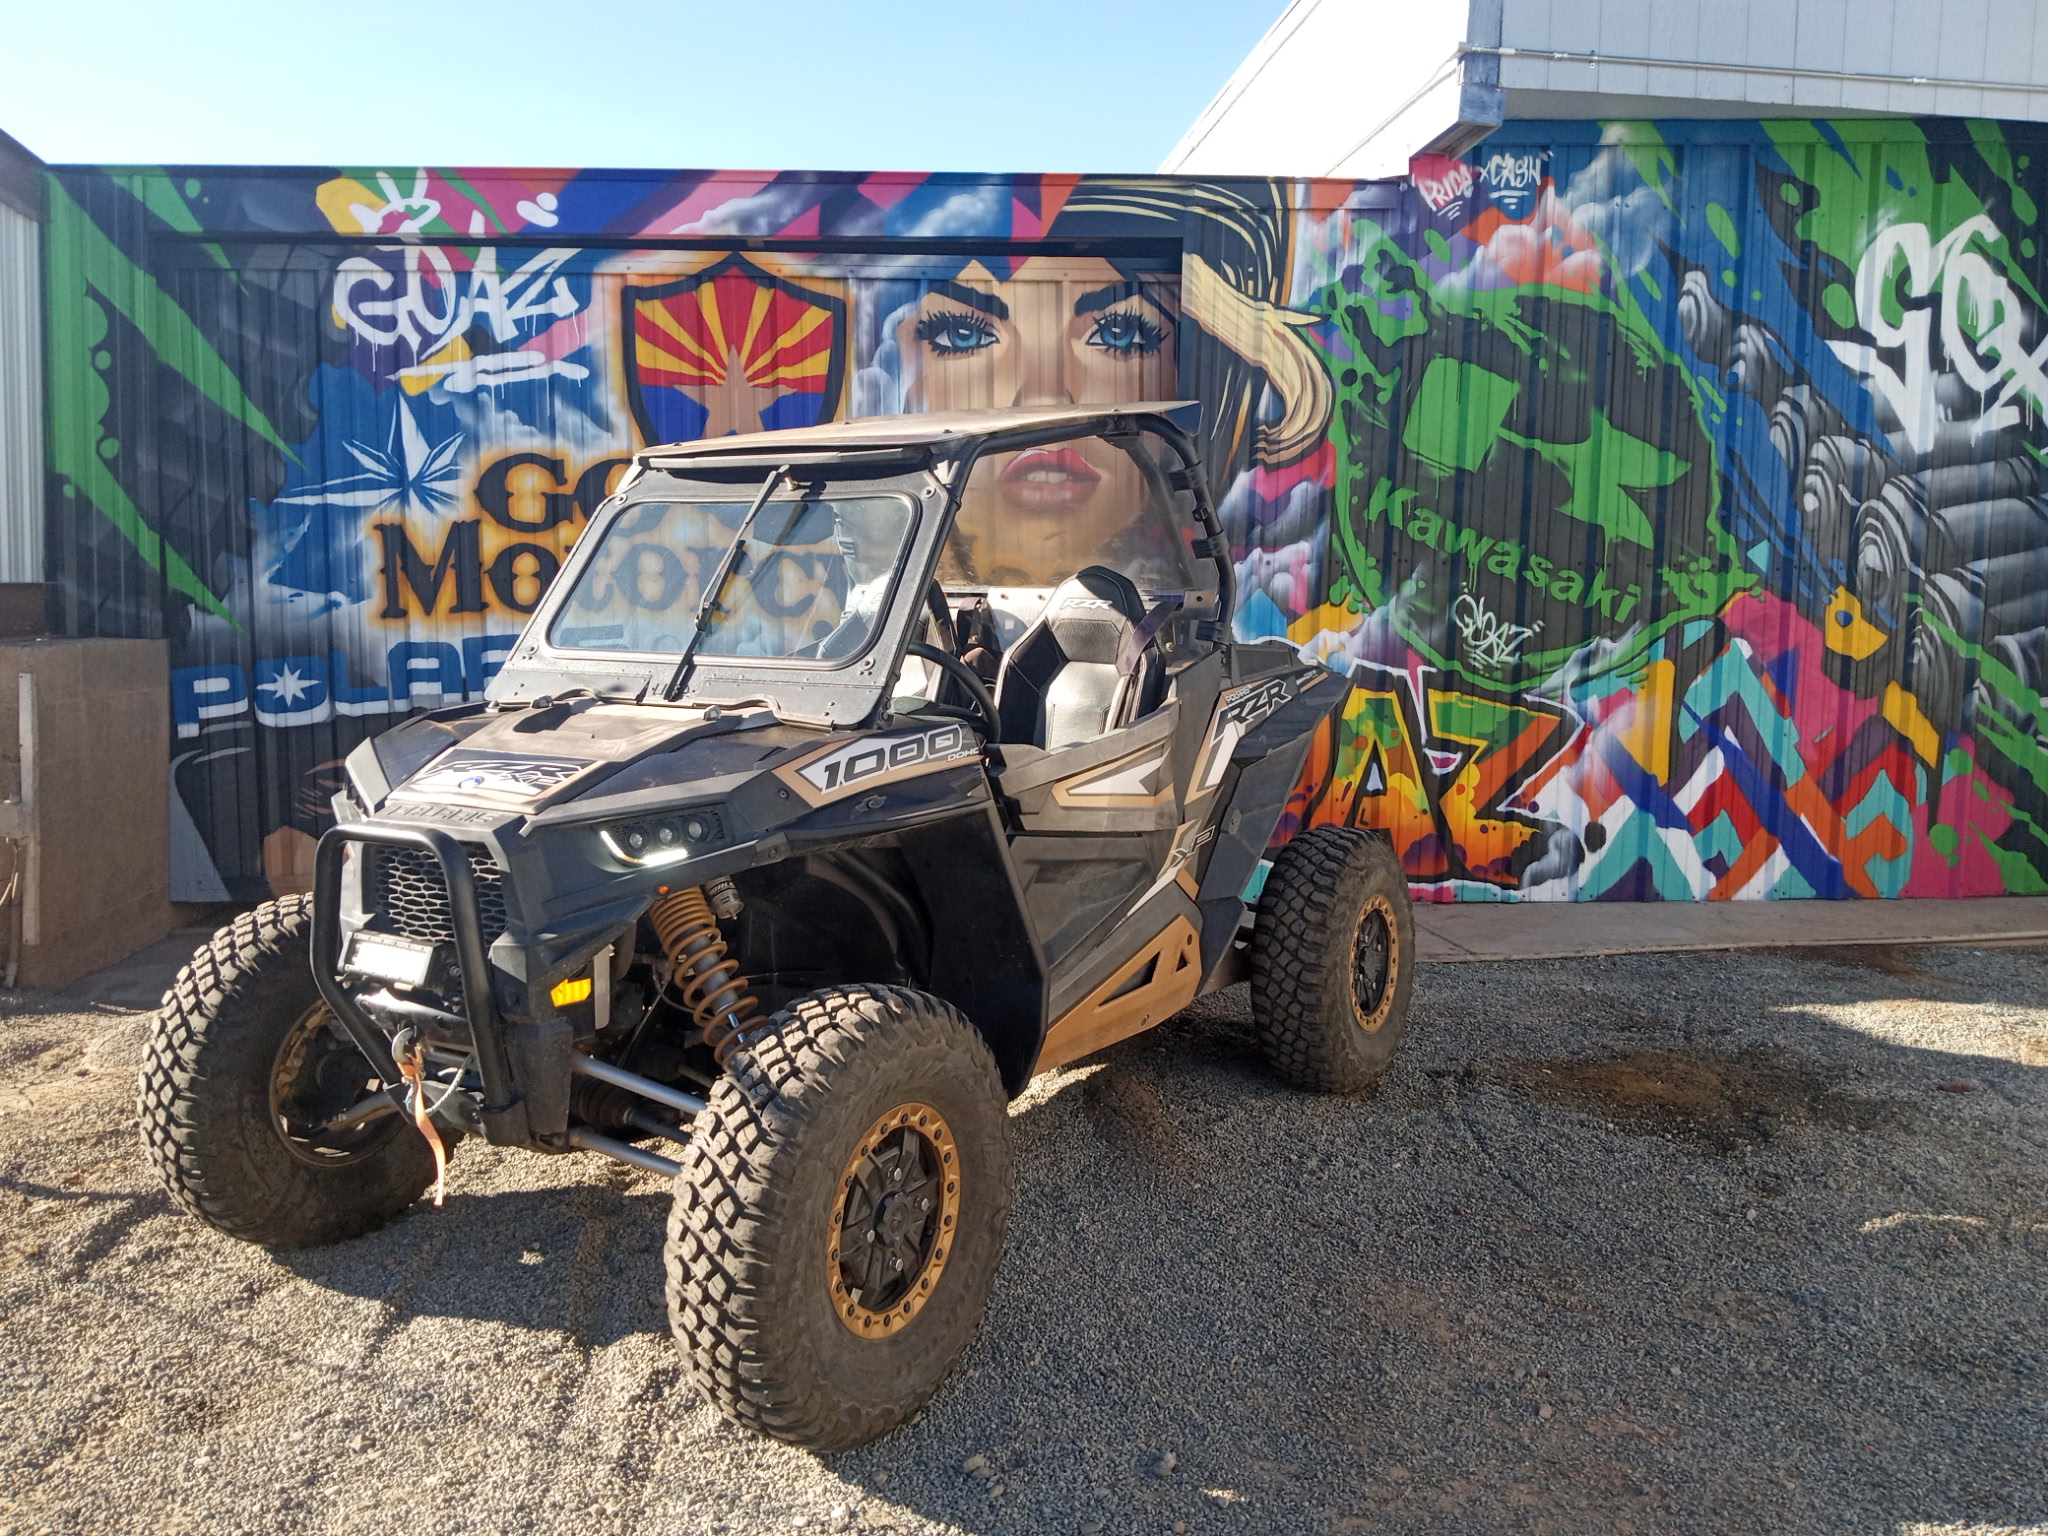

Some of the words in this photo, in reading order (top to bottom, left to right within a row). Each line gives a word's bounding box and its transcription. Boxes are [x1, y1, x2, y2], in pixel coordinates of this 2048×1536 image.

[1362, 475, 1641, 624] Kawasaki
[1211, 679, 1292, 742] RZR
[820, 724, 963, 794] 1000
[947, 747, 980, 762] DOHC
